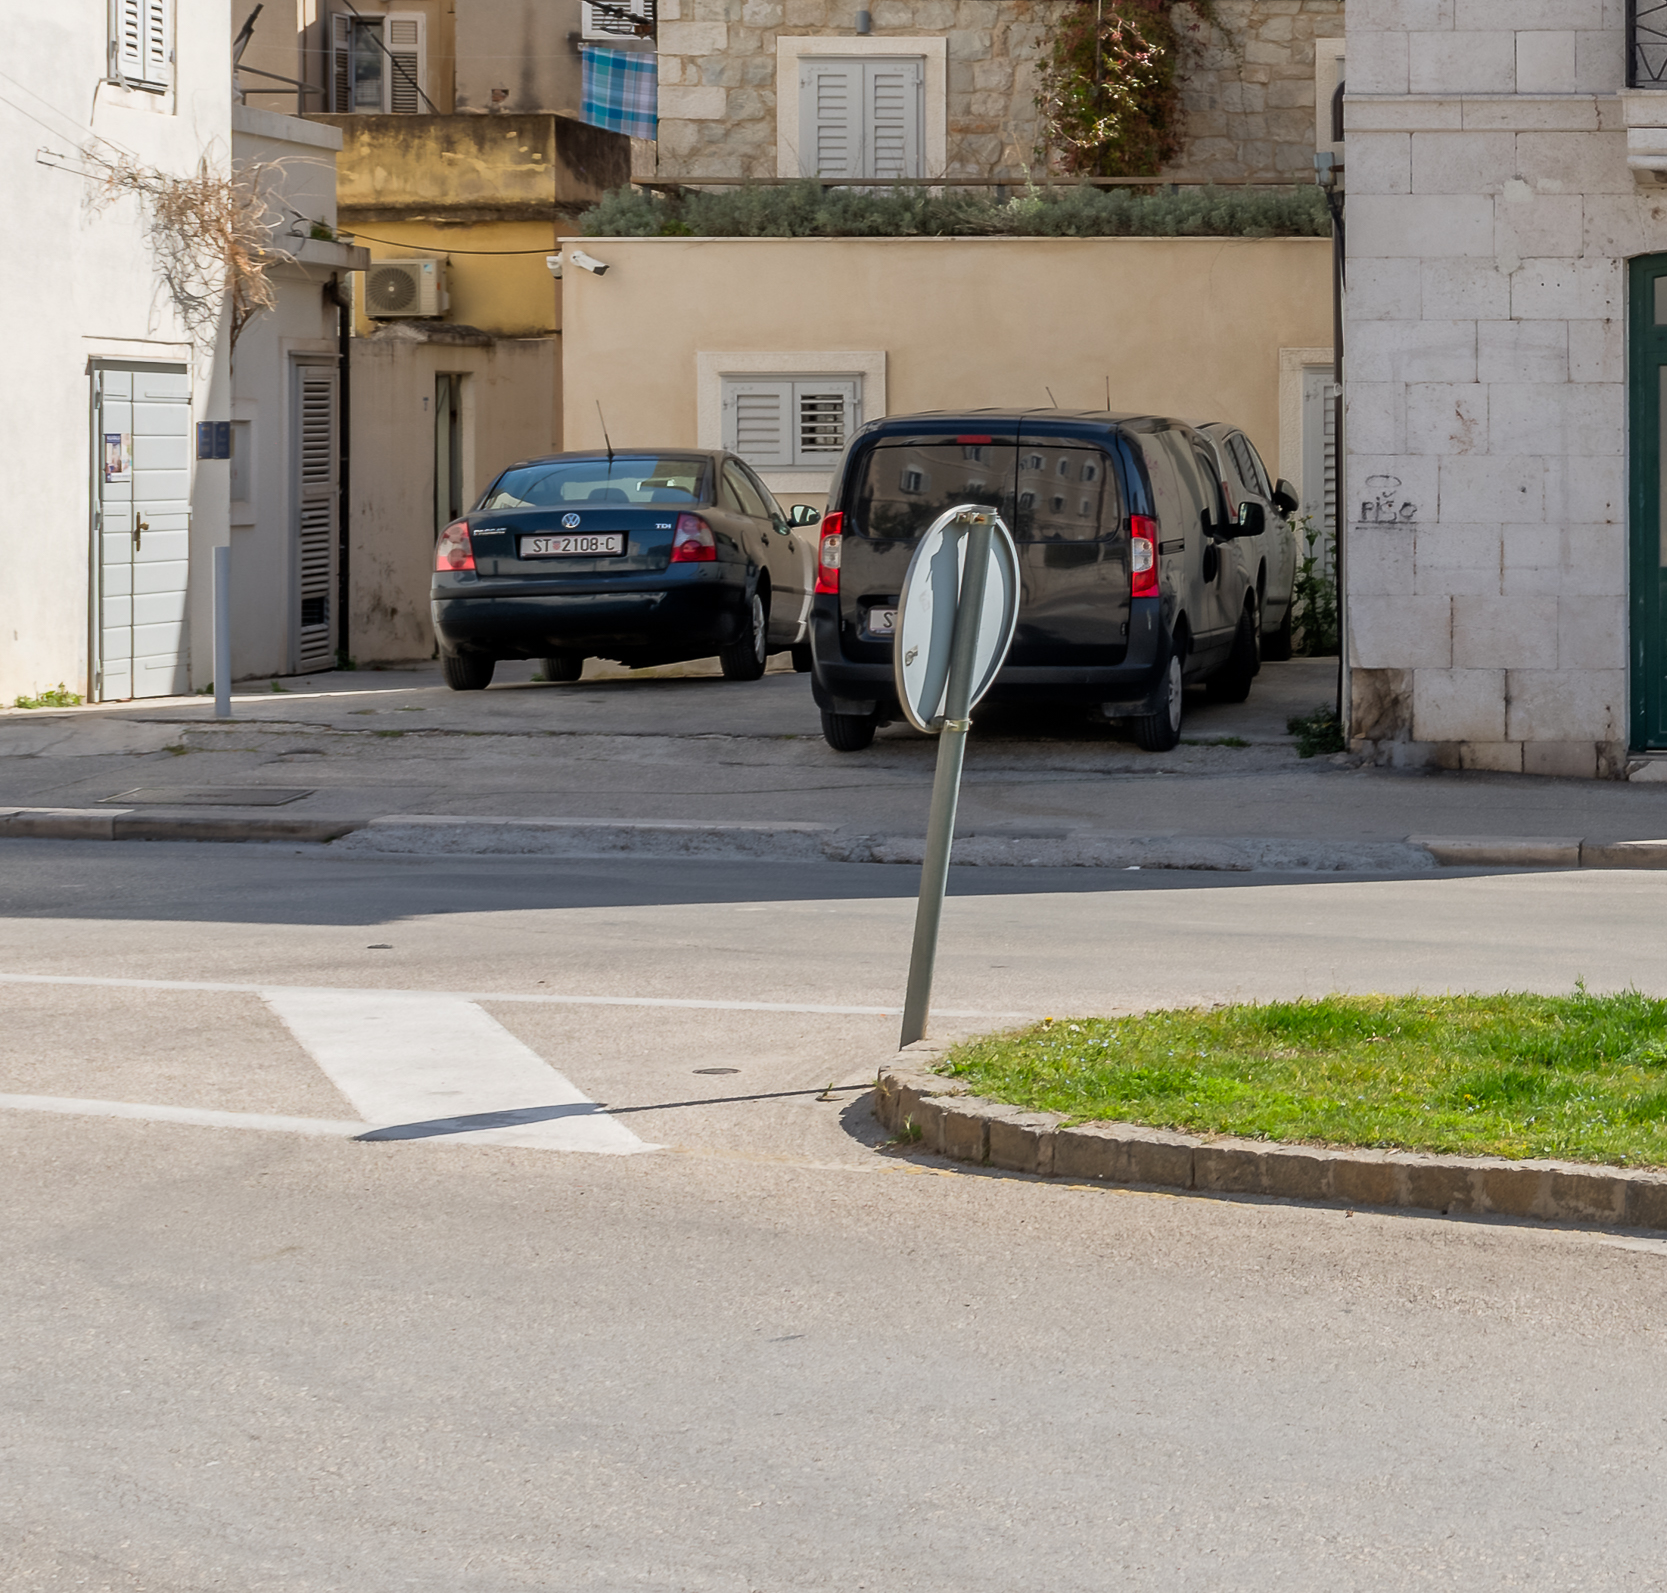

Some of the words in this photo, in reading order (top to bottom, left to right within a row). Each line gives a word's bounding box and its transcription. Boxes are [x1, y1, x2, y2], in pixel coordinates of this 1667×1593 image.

[533, 538, 552, 553] ST
[562, 537, 615, 552] 2108-C
[883, 612, 898, 628] S
